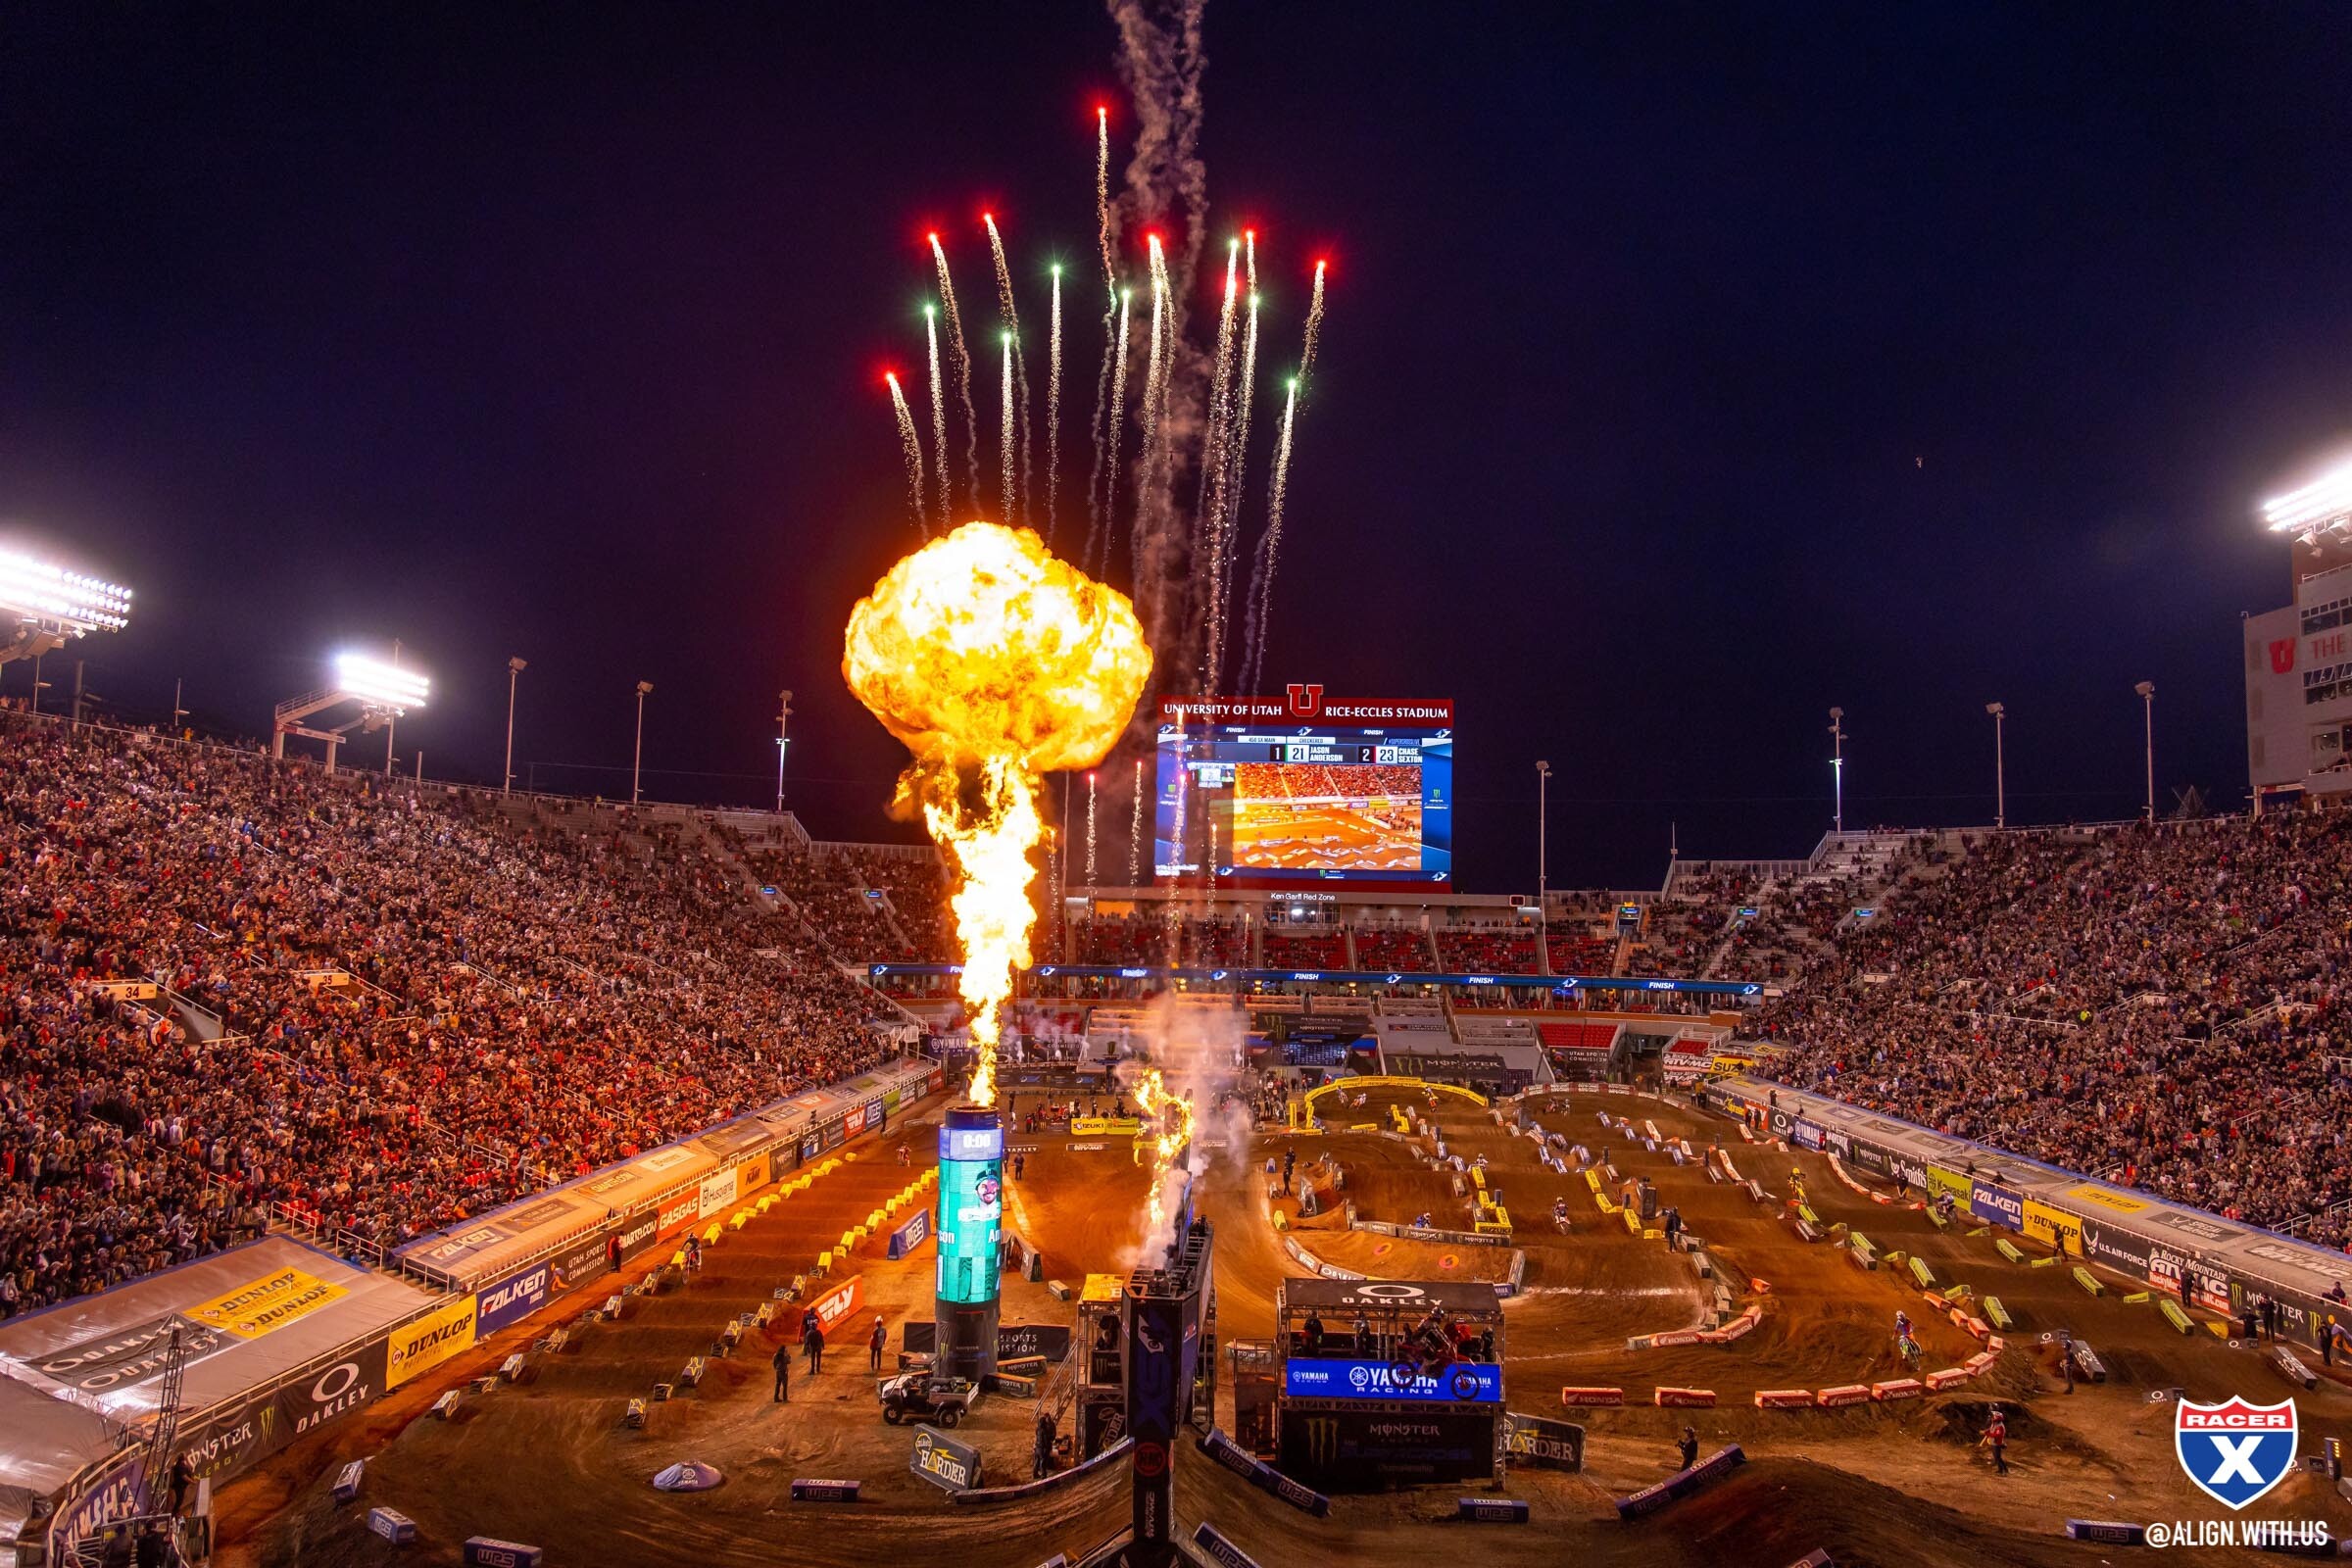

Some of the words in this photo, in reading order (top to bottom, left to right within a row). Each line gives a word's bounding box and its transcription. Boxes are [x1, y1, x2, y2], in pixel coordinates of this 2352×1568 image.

[2311, 634, 2345, 660] THE
[1164, 704, 1230, 715] UNIVERSITY
[1233, 705, 1248, 715] OF
[1251, 706, 1282, 715] UTAH
[1286, 684, 1323, 717] U
[1325, 707, 1393, 717] RICE-ECCLES
[1396, 708, 1448, 718] STADIUM
[1275, 747, 1280, 760] 1
[1293, 747, 1304, 760] 21
[1362, 749, 1370, 761] 2
[1380, 749, 1395, 761] 23
[322, 975, 332, 985] 35
[125, 987, 139, 999] 34
[963, 1134, 991, 1148] 0:00
[1801, 1123, 1820, 1143] YAMAH
[709, 1181, 734, 1203] Husqvarna
[1936, 1180, 1971, 1202] Kwasaki
[1974, 1189, 2022, 1216] FALKEN
[659, 1197, 699, 1231] GASGAS
[430, 1227, 496, 1260] FALKEN
[568, 1255, 584, 1268] UTAH
[586, 1242, 607, 1261] SPORTS
[2099, 1243, 2111, 1253] U.S.
[2111, 1247, 2123, 1258] AIR
[2123, 1252, 2148, 1268] FORCE
[2161, 1249, 2184, 1266] ROCKY
[2185, 1259, 2229, 1282] MOUNTAIN
[568, 1256, 606, 1281] COMMISSION
[220, 1272, 296, 1311] DUNLOP
[480, 1269, 546, 1318] FALKEN
[817, 1284, 854, 1322] FLY
[1342, 1297, 1443, 1306] OAKLEY
[257, 1285, 329, 1325] DUNLOP
[2247, 1291, 2304, 1324] MOSTER
[406, 1313, 472, 1359] DUNLOP
[1000, 1334, 1037, 1343] SPORTS
[1732, 1323, 1753, 1339] HONDA
[1007, 1361, 1038, 1371] MONSTER
[1370, 1368, 1438, 1389] YAHA
[296, 1384, 369, 1434] OAKLEY
[1103, 1412, 1125, 1449] RDER
[1370, 1423, 1441, 1436] MONSTER
[187, 1422, 253, 1472] ONSTER
[194, 1452, 241, 1481] NERGY
[920, 1446, 966, 1486] HARDER
[1220, 1448, 1254, 1477] WPS
[807, 1488, 843, 1499] WPS
[1278, 1481, 1314, 1507] WPS
[1476, 1507, 1515, 1520] WPS
[2090, 1527, 2130, 1543] WPS
[477, 1549, 515, 1568] WPS
